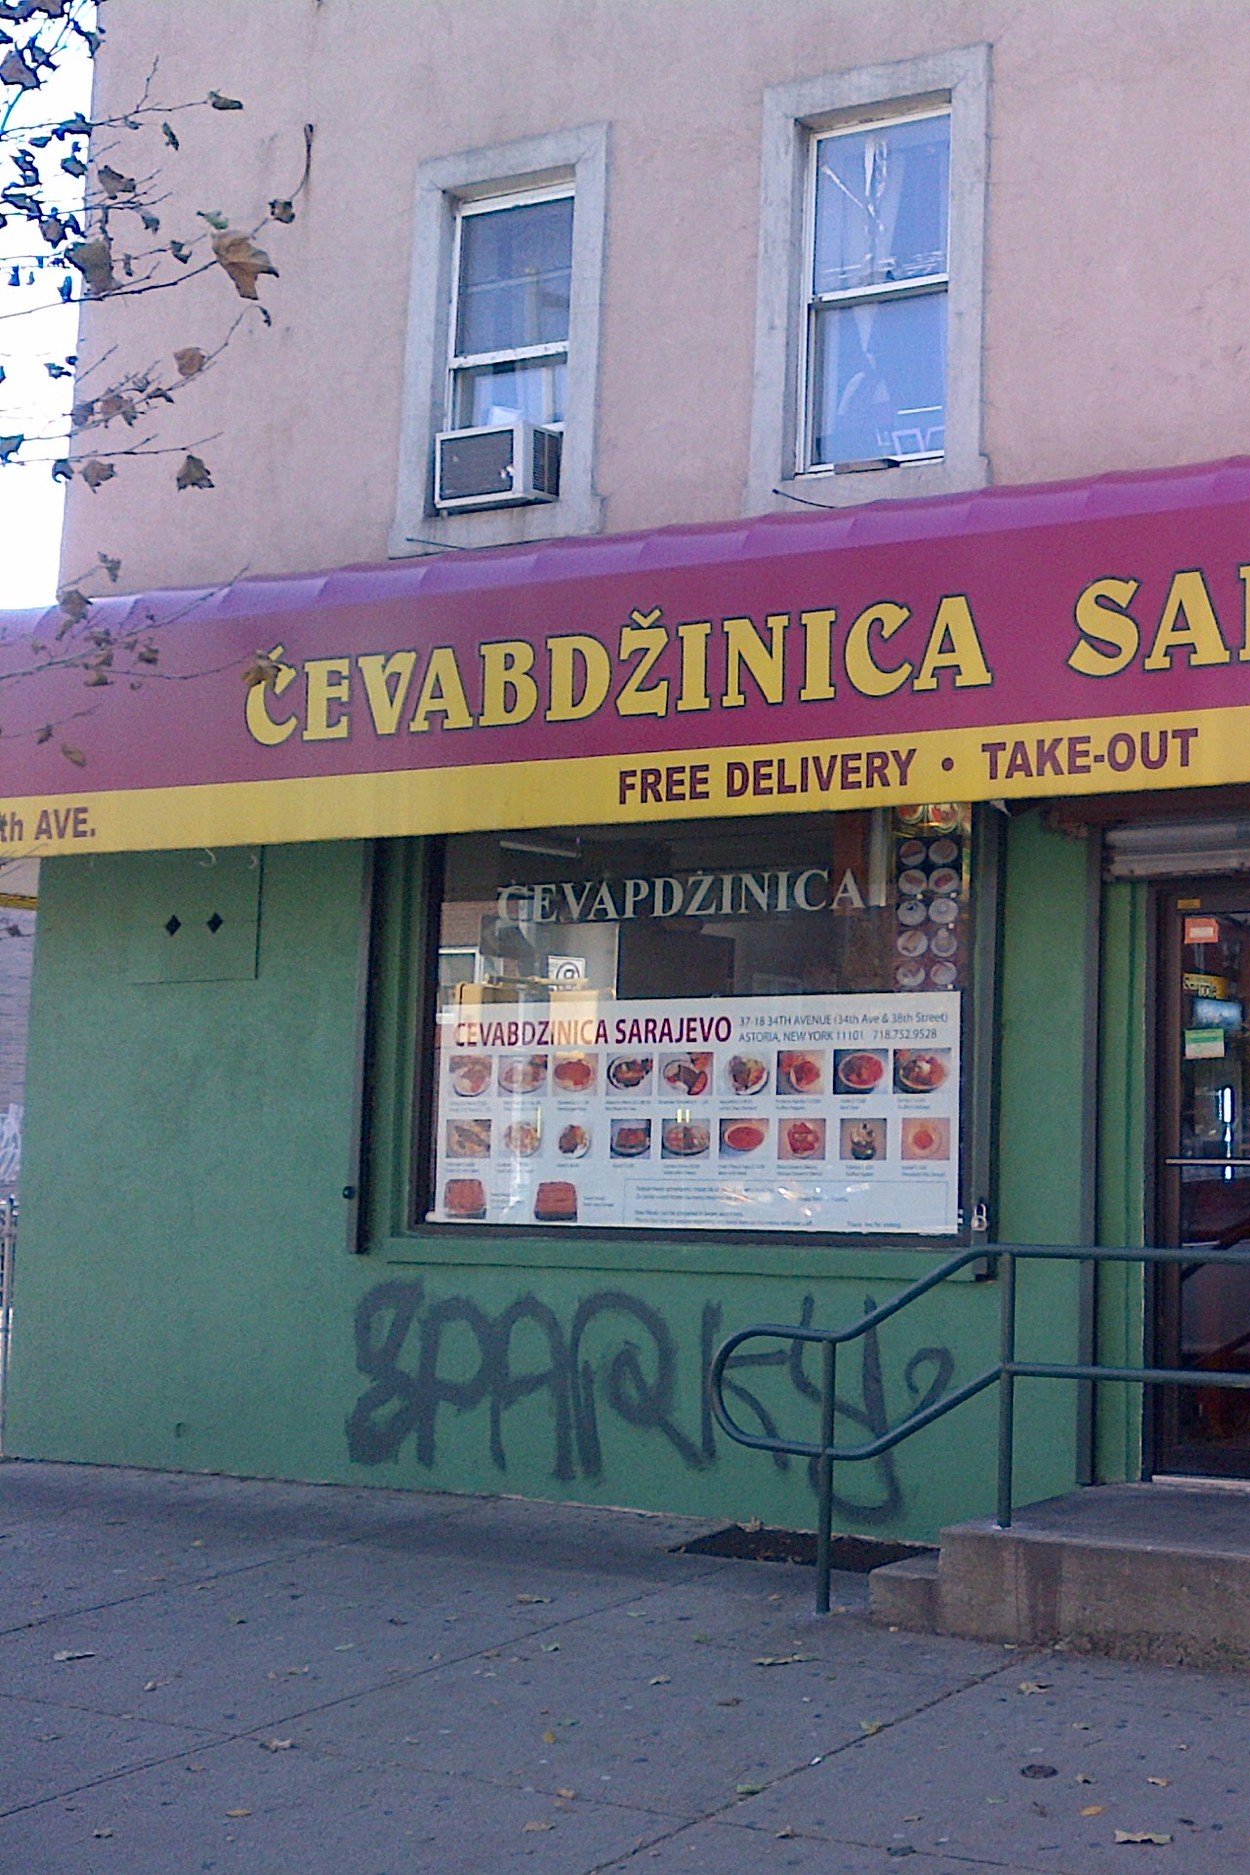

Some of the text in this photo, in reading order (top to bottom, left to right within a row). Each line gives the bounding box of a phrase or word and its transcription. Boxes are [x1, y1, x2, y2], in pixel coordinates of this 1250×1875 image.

[618, 728, 1199, 806] FREE DELIVERY TAKE-OUT
[34, 806, 96, 841] AVE.
[615, 1016, 732, 1045] SARAJEVO
[793, 1013, 833, 1026] AVENUE
[861, 1012, 880, 1024] Ave
[783, 1030, 806, 1043] NEW
[807, 1030, 834, 1042] YORK
[872, 1027, 938, 1041] 718.752.9528
